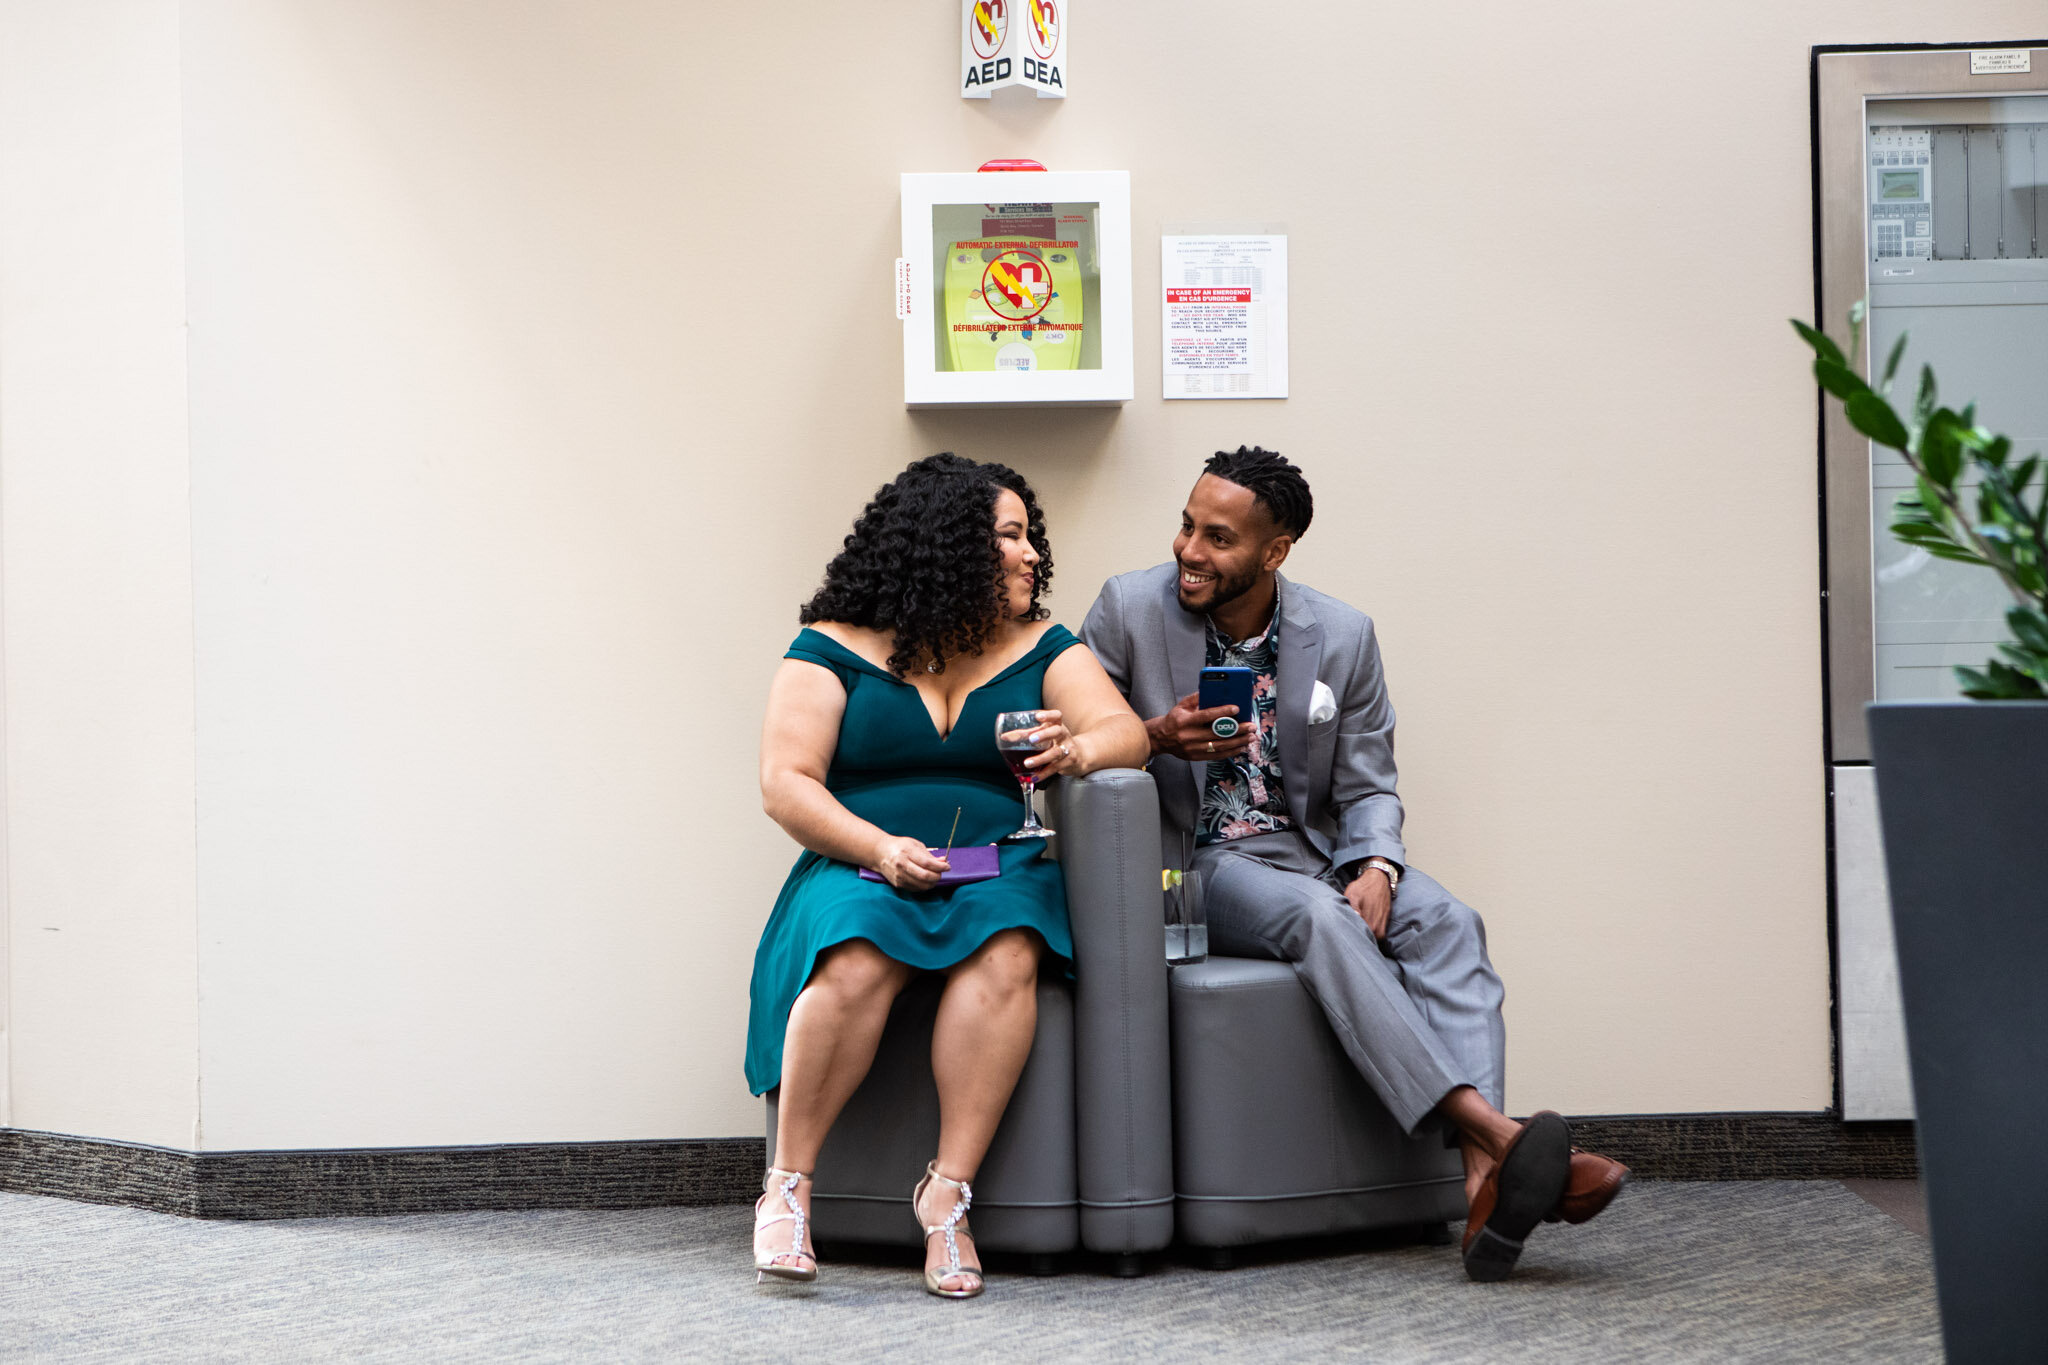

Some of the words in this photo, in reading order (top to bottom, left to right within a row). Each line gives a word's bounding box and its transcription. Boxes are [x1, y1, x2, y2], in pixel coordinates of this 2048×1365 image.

[964, 57, 1012, 88] AED
[1024, 57, 1062, 88] DEA
[906, 284, 911, 293] TO
[954, 324, 1007, 332] DÉFIBRILLATEUR
